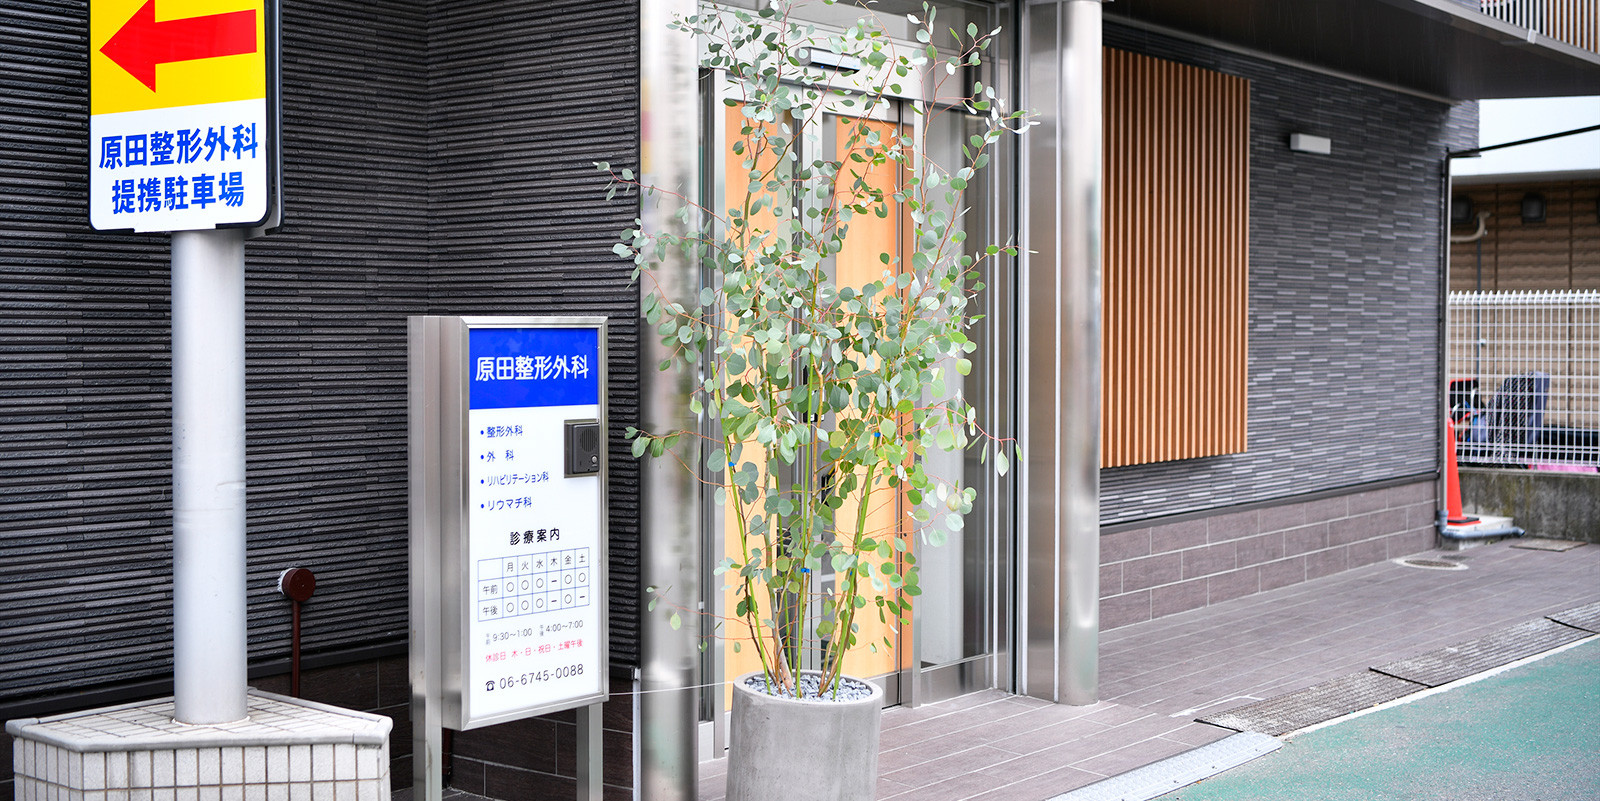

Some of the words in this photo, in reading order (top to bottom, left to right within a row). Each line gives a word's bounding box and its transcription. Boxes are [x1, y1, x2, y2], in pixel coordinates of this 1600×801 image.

[99, 122, 258, 169] 原田整形外科
[112, 171, 244, 214] 提携駐車場
[476, 355, 589, 381] 原田整形外科
[487, 425, 523, 438] 整形外科
[488, 471, 549, 486] リハビリテーション科
[488, 497, 532, 511] リウマチ科
[510, 527, 560, 545] 診療案内
[483, 584, 498, 595] 午前
[483, 605, 498, 616] 午後
[499, 664, 584, 689] 06-6745-0088
